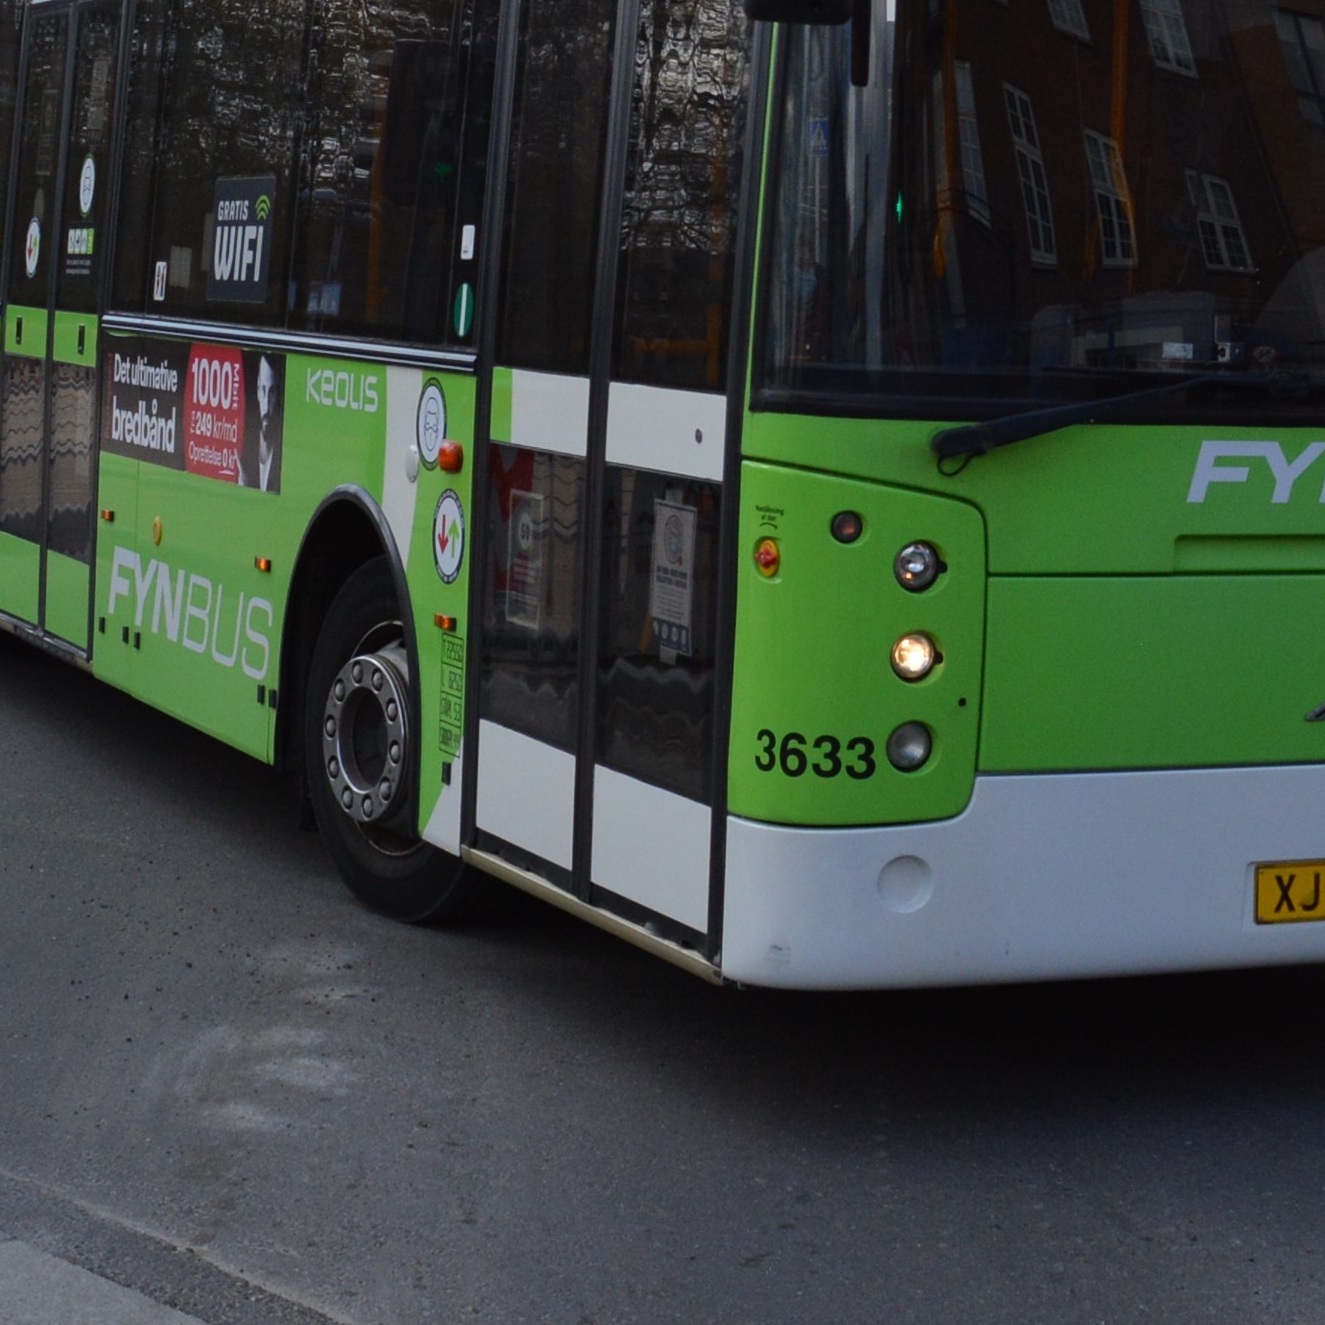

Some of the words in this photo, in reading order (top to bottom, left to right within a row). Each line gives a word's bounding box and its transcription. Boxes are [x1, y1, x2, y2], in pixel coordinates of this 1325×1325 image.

[217, 199, 250, 221] GRATIS
[213, 225, 264, 282] WIFI
[113, 353, 130, 383] Det
[131, 355, 178, 393] ultimative
[191, 357, 232, 410] 1000
[111, 395, 176, 454] bredbånd
[196, 411, 212, 437] 249
[212, 414, 238, 443] kr/md
[189, 440, 222, 467] Oprettelse
[106, 544, 274, 682] FYNBUS
[754, 728, 877, 780] 3633
[1273, 875, 1322, 914] XJ
